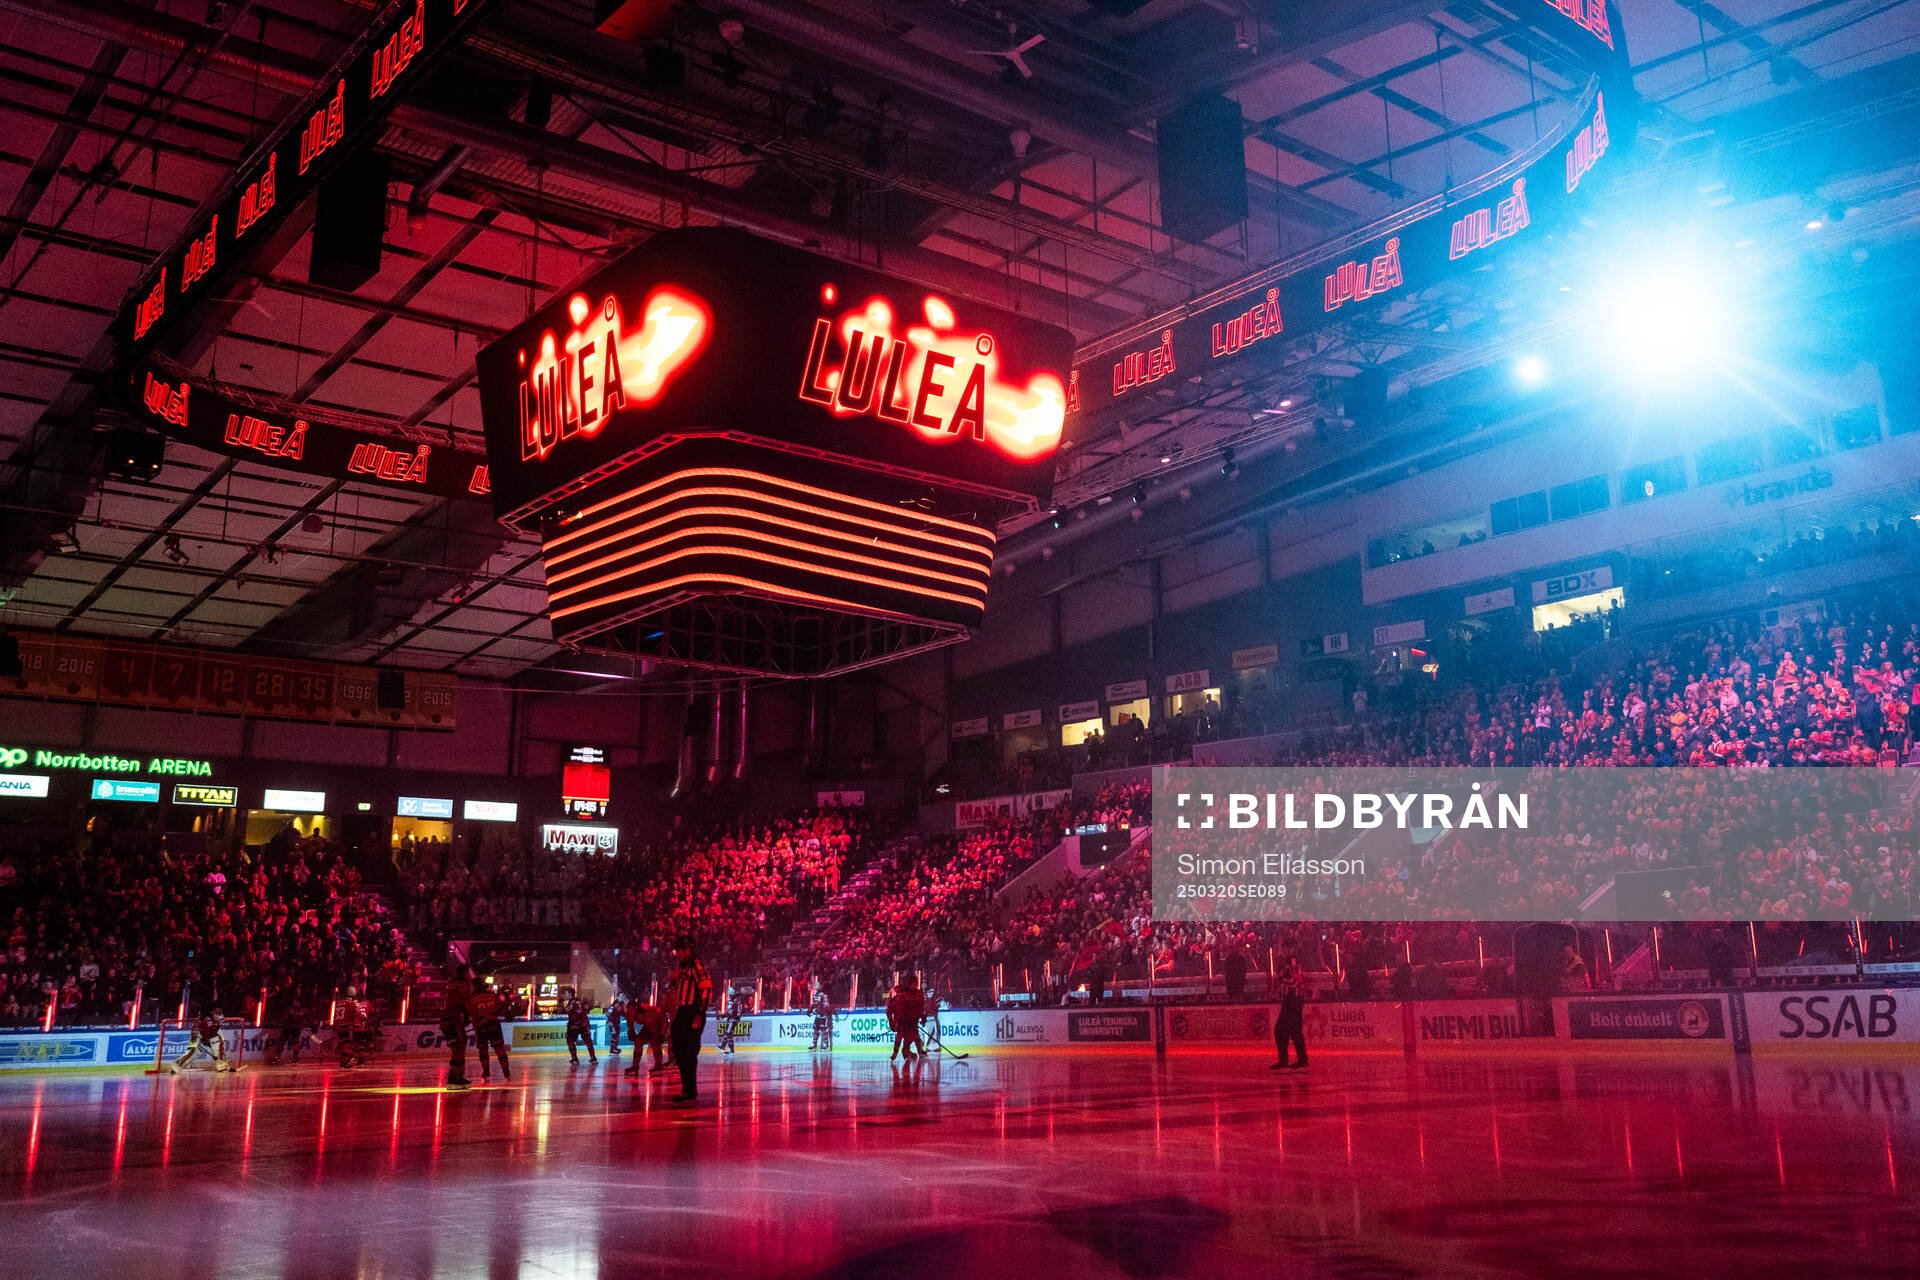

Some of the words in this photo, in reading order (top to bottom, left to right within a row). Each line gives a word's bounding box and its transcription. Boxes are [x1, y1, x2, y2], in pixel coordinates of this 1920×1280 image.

[1449, 178, 1530, 260] LULEÅ
[1324, 237, 1403, 312] LULEÅ
[1212, 288, 1283, 358] LULEÅ
[1112, 330, 1176, 397] LULEÅ
[520, 296, 626, 461] LULEÅ
[800, 318, 995, 441] LULEÅ
[224, 413, 310, 461] LULEÅ
[347, 443, 432, 484] LULEÅ
[1546, 571, 1598, 596] BDX
[58, 657, 94, 674] 2016
[120, 658, 136, 683] 4
[170, 663, 184, 686] 7
[211, 668, 236, 692] 12
[256, 672, 285, 697] 28
[301, 677, 327, 700] 35
[342, 684, 372, 699] 1996
[1175, 671, 1202, 689] ABB
[35, 751, 141, 772] Norrbotten
[148, 758, 213, 777] ARENA
[178, 786, 234, 800] TITAN
[851, 1018, 878, 1031] COOP
[1078, 1016, 1102, 1026] LULEÅ
[1421, 1015, 1485, 1040] NIEMI
[1625, 1011, 1673, 1027] enkelt
[1779, 994, 1897, 1038] SSAB
[522, 1032, 568, 1040] ZEPPELI
